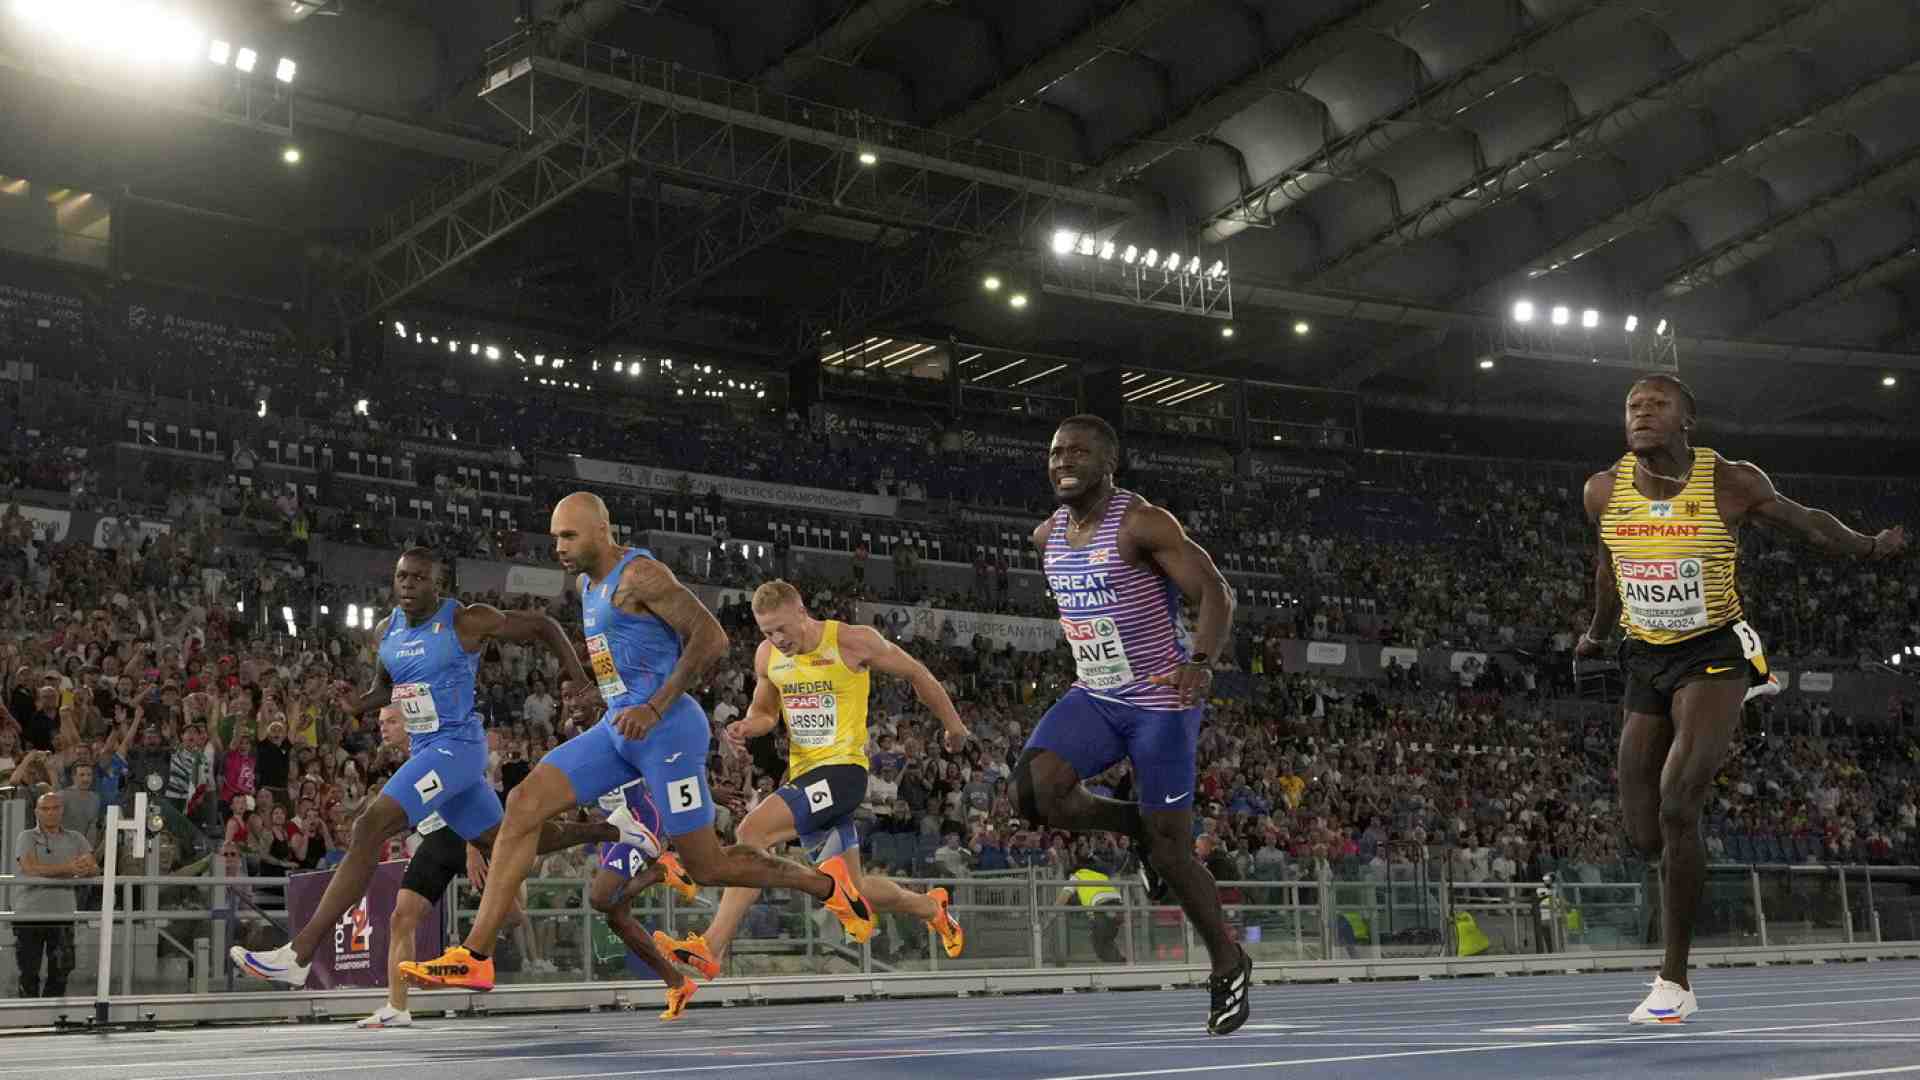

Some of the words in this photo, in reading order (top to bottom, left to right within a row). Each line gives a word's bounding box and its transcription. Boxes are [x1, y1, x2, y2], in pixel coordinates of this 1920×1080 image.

[1616, 525, 1702, 537] GERMANY
[1622, 562, 1676, 578] SPAR
[1048, 573, 1108, 590] GREAT
[1626, 581, 1700, 603] ANSAH
[1668, 617, 1696, 629] 2024
[791, 714, 834, 728] ARSSON
[422, 780, 438, 794] 7
[680, 784, 692, 808] 5
